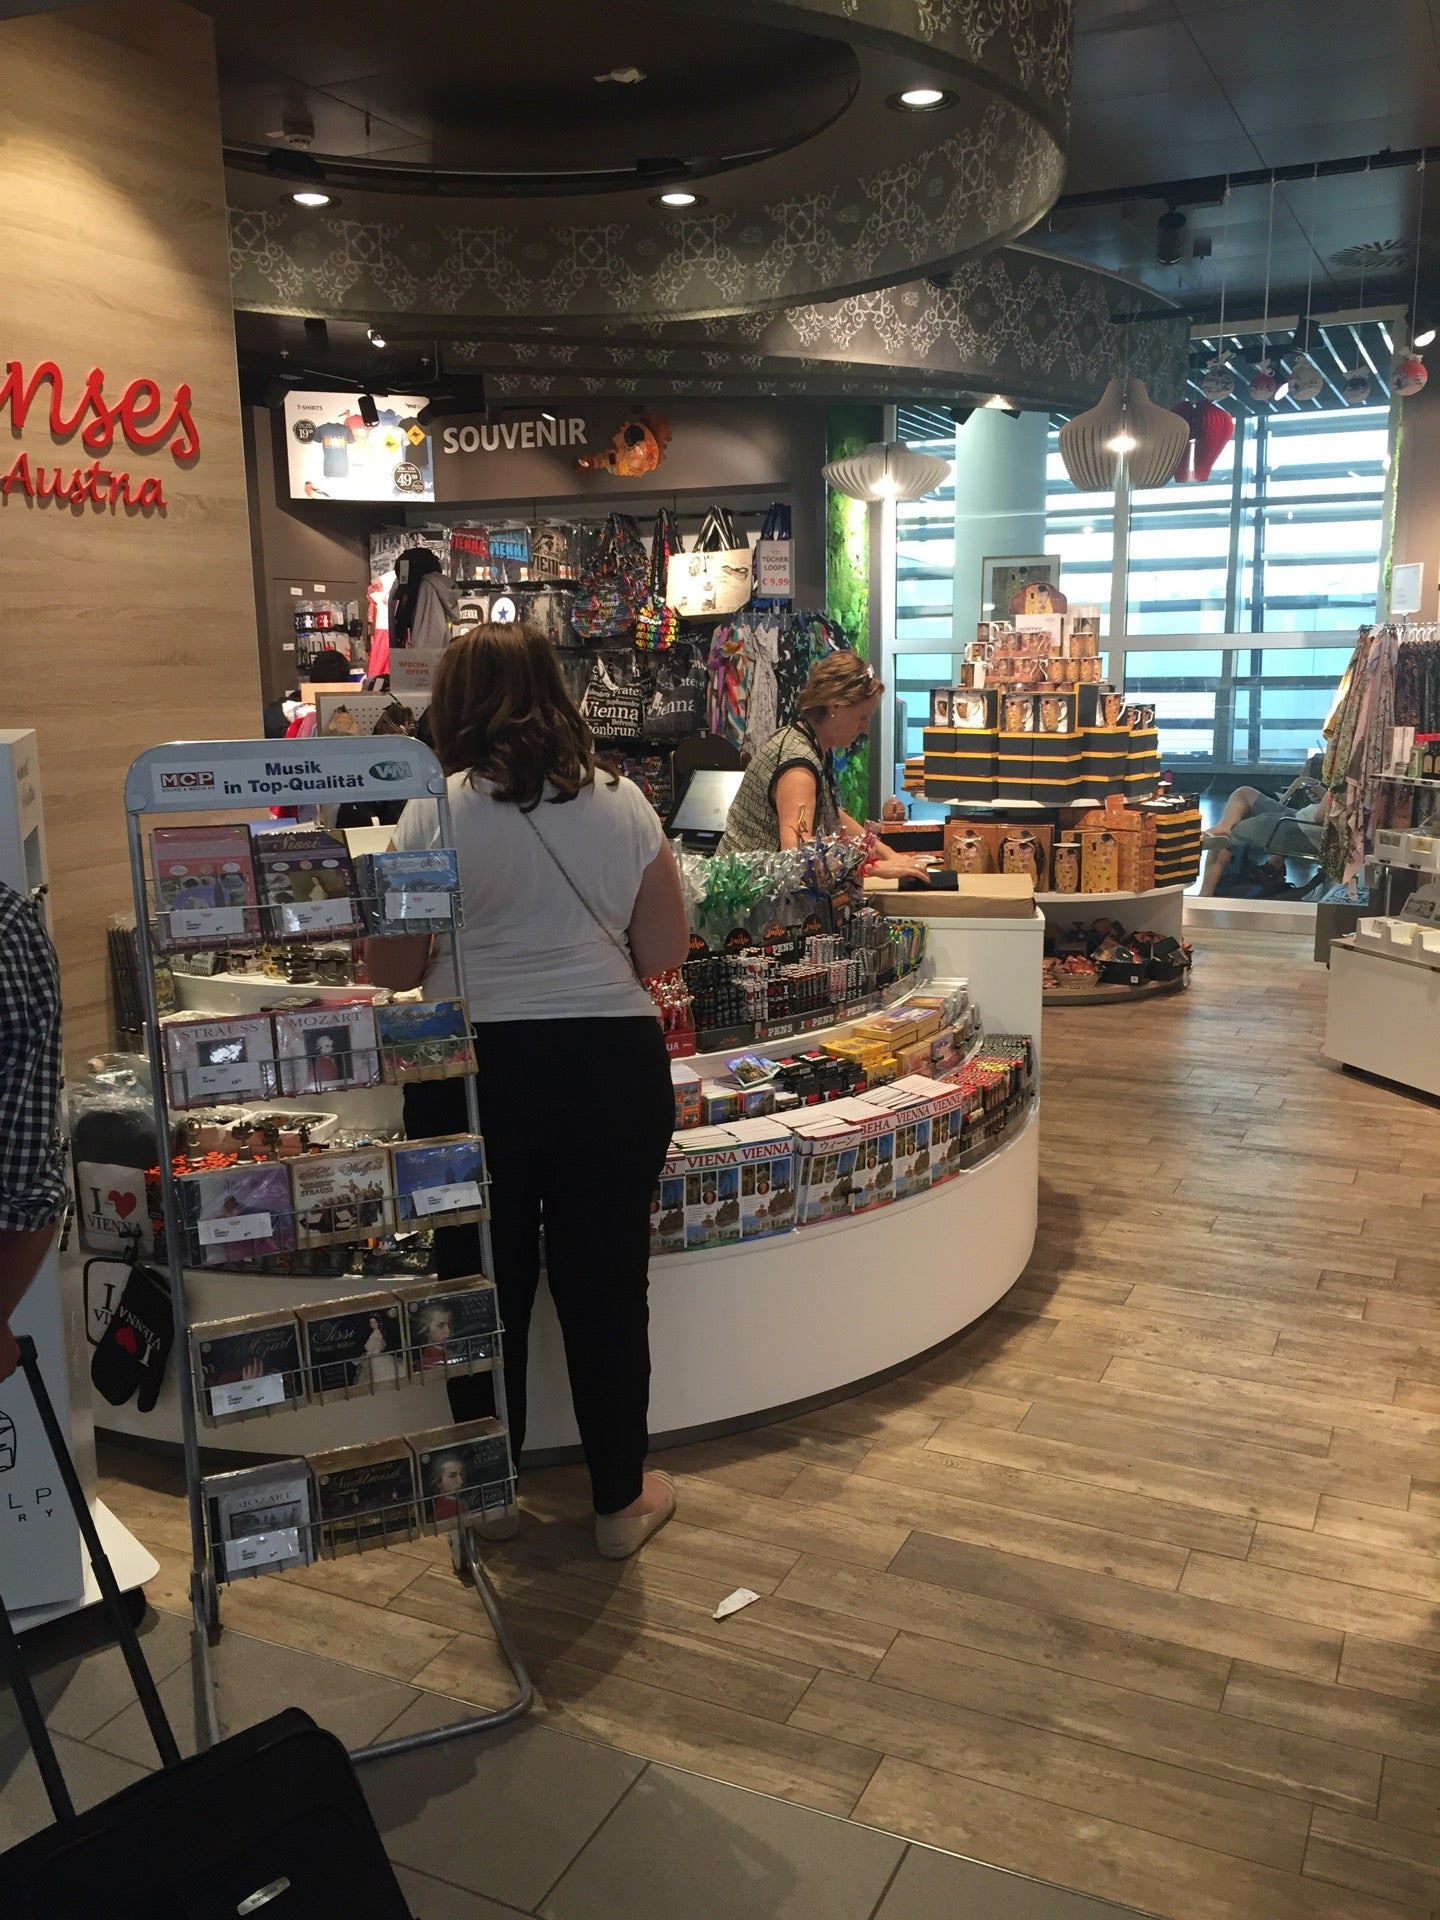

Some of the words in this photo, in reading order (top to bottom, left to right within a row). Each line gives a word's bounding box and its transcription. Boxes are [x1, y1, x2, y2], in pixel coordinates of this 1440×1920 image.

[443, 418, 588, 454] SOUVENIR
[451, 537, 488, 560] VIENNA
[490, 541, 528, 562] VIENNA
[584, 701, 639, 721] Vienna
[265, 761, 322, 776] Musik
[161, 772, 213, 787] MCP
[223, 781, 242, 795] in
[247, 774, 365, 794] Top-Qualität
[274, 835, 320, 850] Sissi
[772, 942, 794, 955] PENS
[289, 1010, 363, 1029] MOZART
[846, 1004, 866, 1017] PENS
[811, 1014, 834, 1027] PENS
[182, 1024, 259, 1040] STRAUSS
[767, 1023, 793, 1037] PENS
[896, 1104, 930, 1124] VIENNA
[741, 1142, 791, 1160] VIENNA
[820, 1136, 856, 1151] ウィーン
[686, 1151, 738, 1169] VIENA
[300, 1187, 333, 1197] STRAUSS
[90, 1187, 103, 1216] I
[87, 1214, 143, 1236] VIENNA
[103, 1283, 116, 1310] I
[118, 1305, 161, 1350] VIENNA
[312, 1321, 357, 1344] Sissi
[138, 1343, 153, 1368] I
[237, 1491, 293, 1509] MOZART
